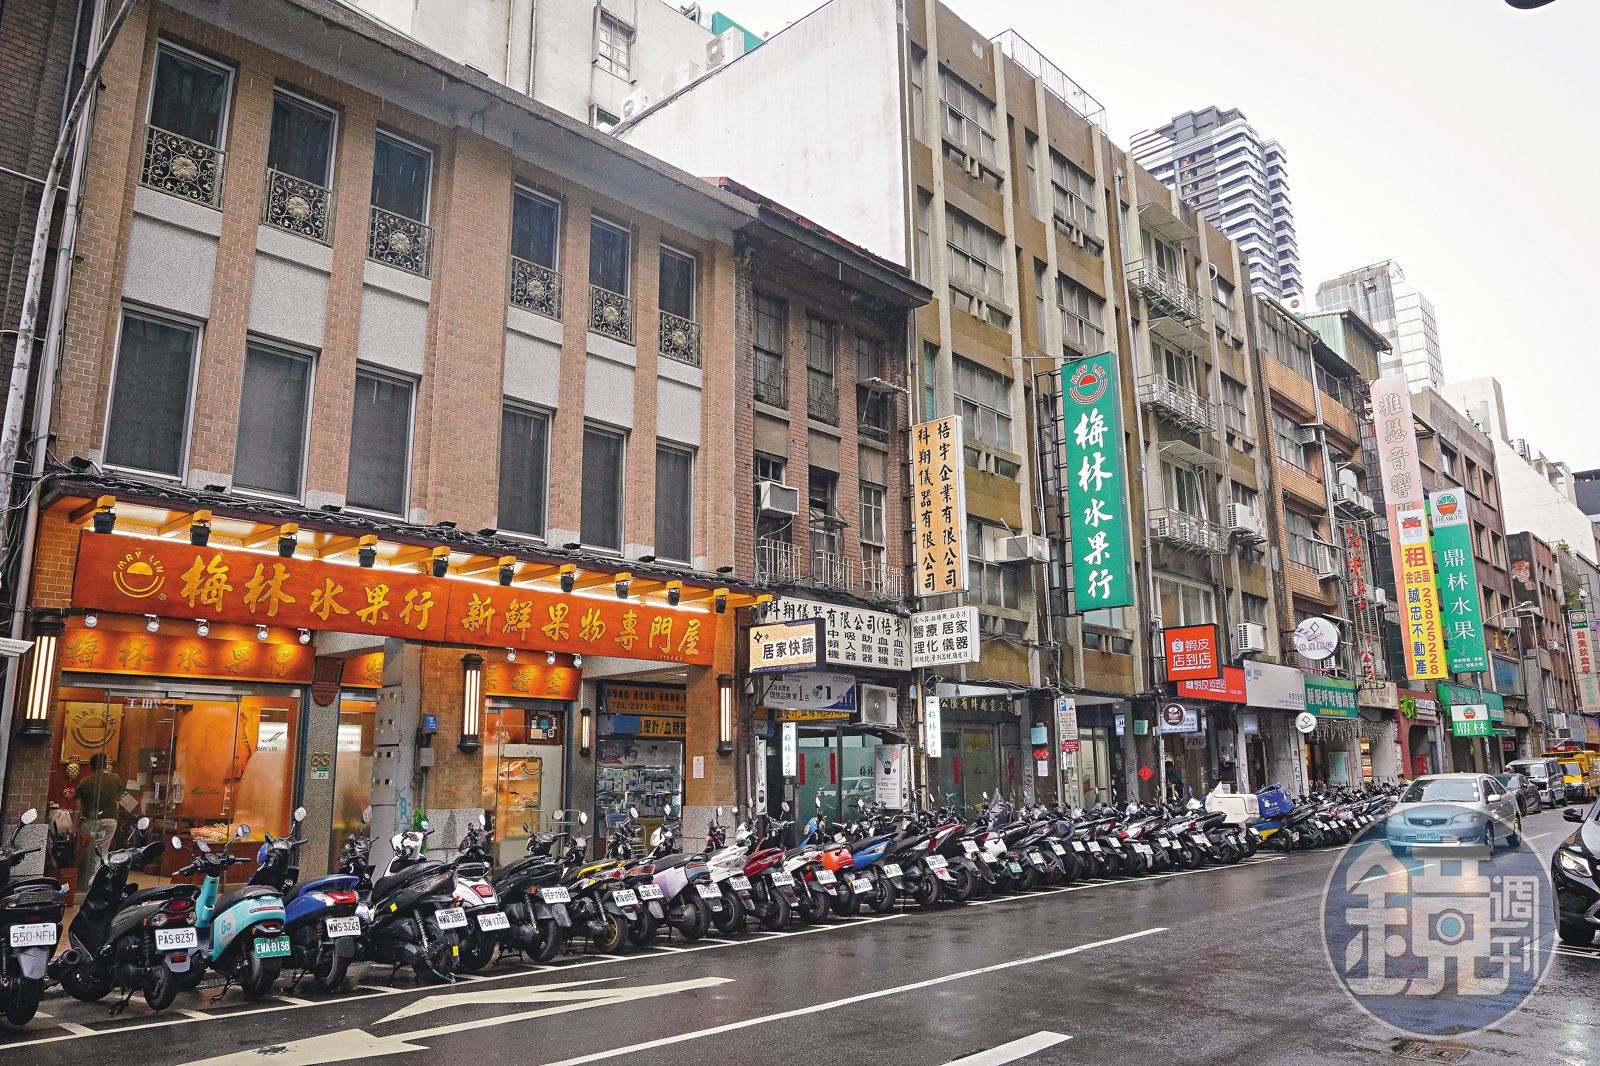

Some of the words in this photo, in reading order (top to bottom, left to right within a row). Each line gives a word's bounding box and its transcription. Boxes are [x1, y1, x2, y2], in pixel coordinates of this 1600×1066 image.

[917, 427, 936, 591] 科翔儀器有限公司
[937, 421, 957, 588] 梧宇企業有限公司
[1074, 407, 1113, 600] 梅林水果行
[117, 551, 141, 570] MAY
[149, 555, 164, 573] LIN
[1405, 546, 1428, 567] 租
[1405, 569, 1431, 584] 金店面
[180, 553, 436, 632] 梅林水果行
[1443, 548, 1476, 641] 鼎林水果
[913, 623, 938, 639] 醫療
[942, 620, 968, 635] 居家
[1408, 587, 1428, 676] 誠忠不動產
[1423, 587, 1440, 675] 23825228
[66, 632, 293, 677] 梅林水果行
[762, 637, 814, 660] 居家快篩
[845, 632, 856, 660] 吸入器
[914, 640, 939, 655] 理化
[942, 636, 968, 652] 儀器
[1185, 638, 1210, 651] 蝦皮
[1173, 651, 1211, 667] 店到店
[1456, 721, 1487, 735] 鼎林
[12, 930, 56, 943] 550-NFH
